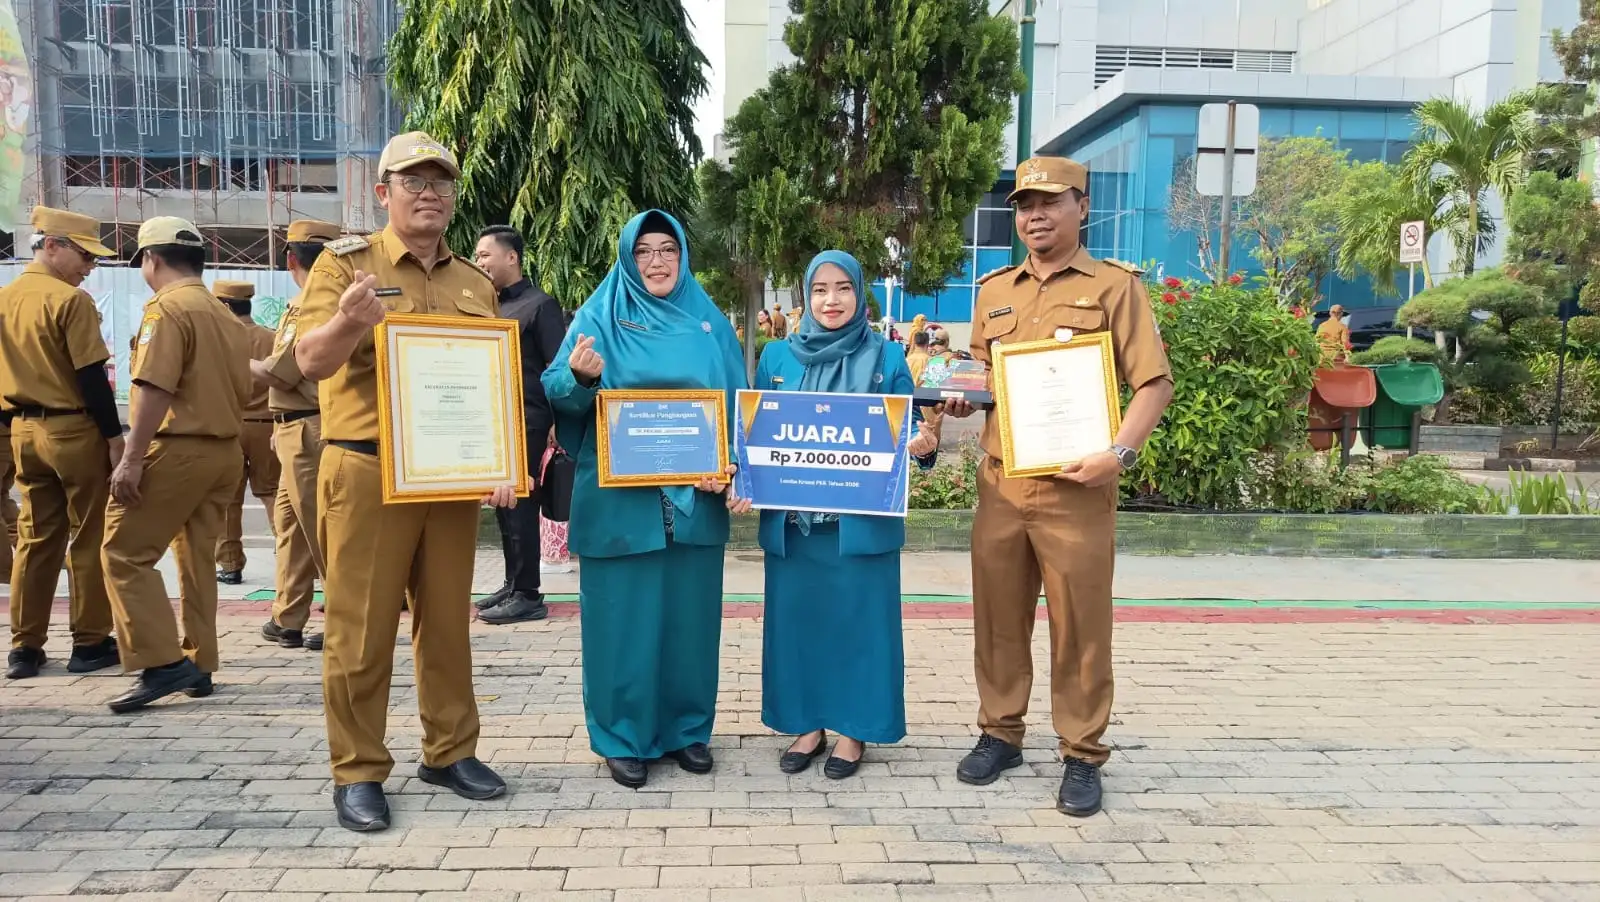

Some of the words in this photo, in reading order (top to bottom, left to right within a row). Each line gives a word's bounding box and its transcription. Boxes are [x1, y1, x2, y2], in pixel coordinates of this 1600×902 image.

[772, 424, 856, 444] JUARA
[864, 428, 870, 444] I
[770, 450, 790, 466] Rp
[795, 452, 871, 466] 7.000.000
